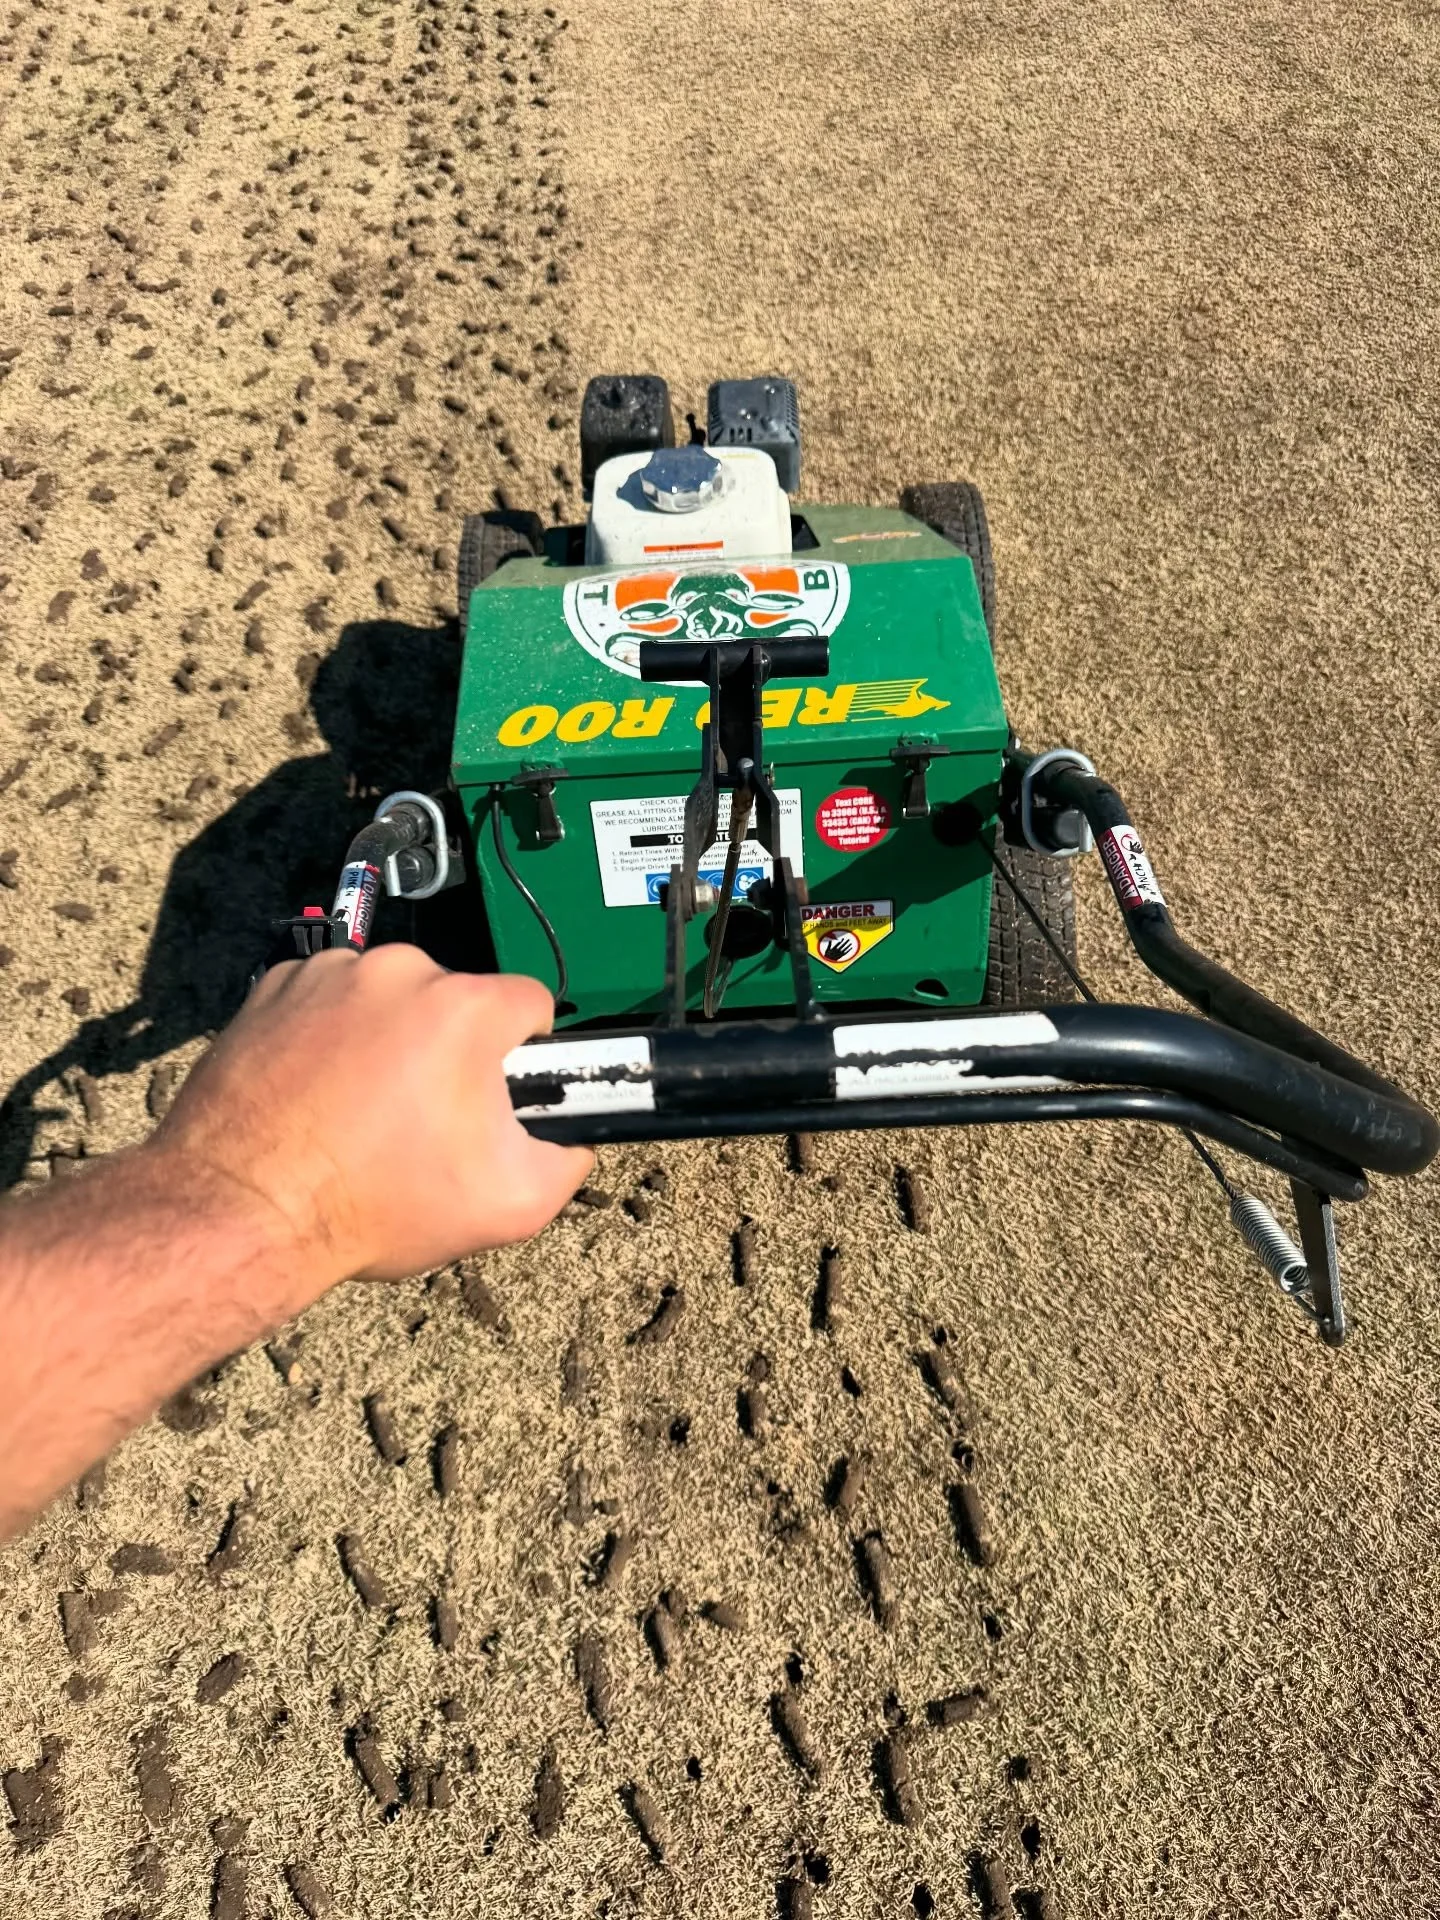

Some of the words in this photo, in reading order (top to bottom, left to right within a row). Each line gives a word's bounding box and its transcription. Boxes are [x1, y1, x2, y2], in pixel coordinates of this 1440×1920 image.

[497, 697, 676, 747] ROO
[640, 798, 666, 807] CHECK
[835, 798, 852, 807] Text
[853, 795, 874, 806] CORE
[596, 809, 626, 818] GREASE
[644, 807, 677, 815] FITTINGS
[822, 810, 831, 818] to
[619, 816, 667, 825] RECOMMEND
[827, 827, 857, 837] helpful
[857, 825, 880, 835] Video
[667, 834, 684, 844] TO
[838, 835, 870, 846] Tutorial
[1102, 836, 1132, 891] DANGER
[355, 881, 374, 937] DANGER
[801, 903, 875, 921] DANGER
[810, 920, 834, 929] HANDS
[849, 919, 866, 927] FEET
[866, 917, 887, 925] AWAY
